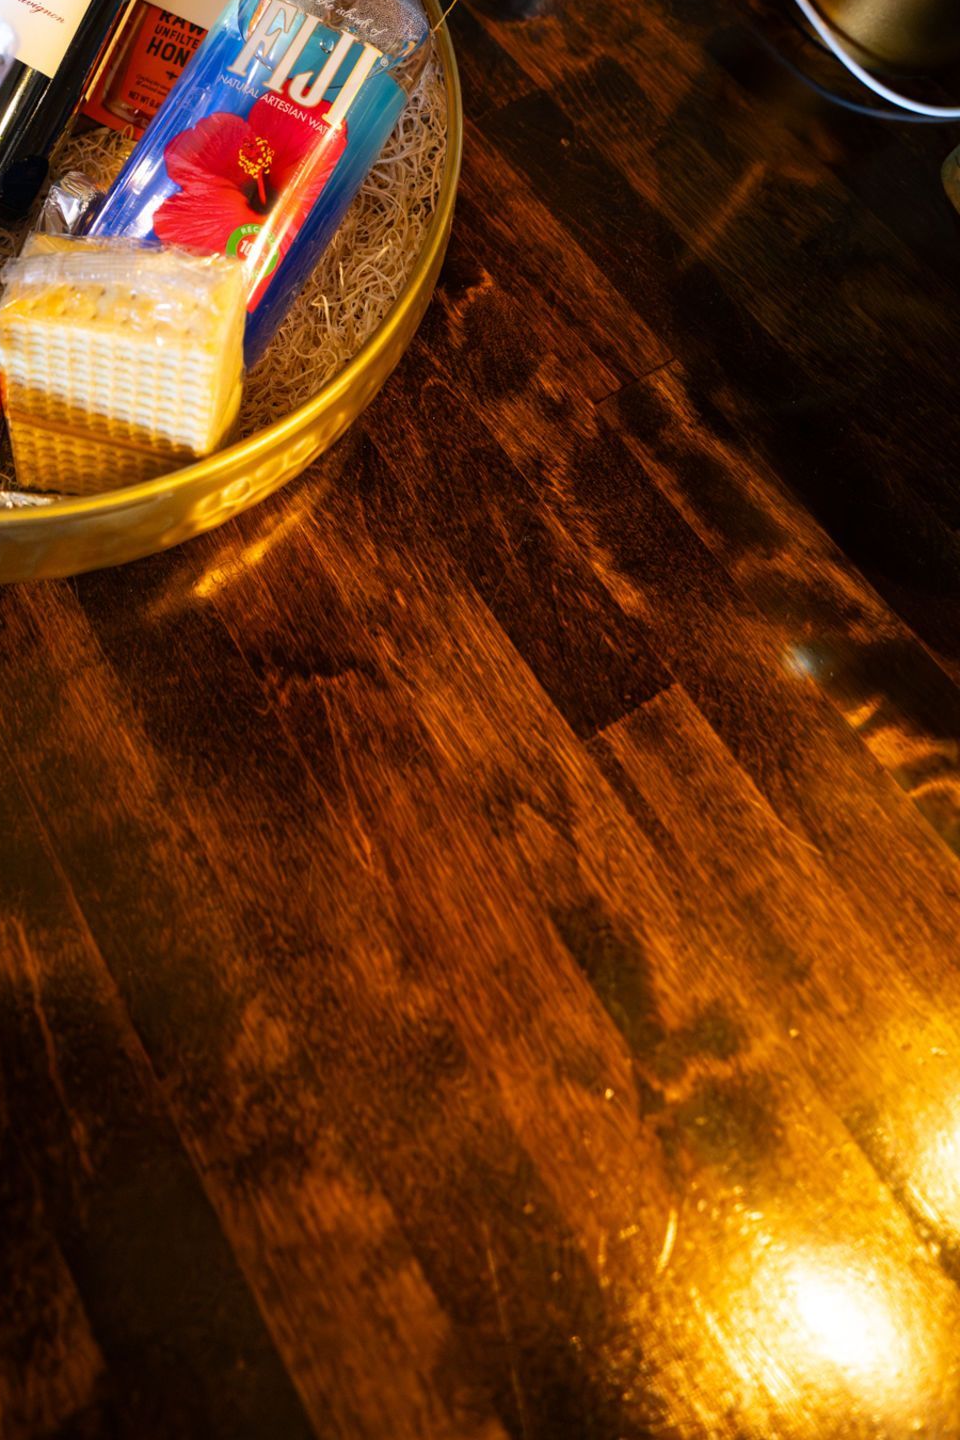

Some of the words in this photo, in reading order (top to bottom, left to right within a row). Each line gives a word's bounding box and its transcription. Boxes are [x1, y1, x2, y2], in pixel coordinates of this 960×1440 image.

[154, 23, 200, 50] UNFILTE
[158, 9, 205, 36] RAW
[145, 36, 191, 68] HON
[217, 73, 259, 100] NATURAL
[260, 92, 308, 122] ARTESIAN
